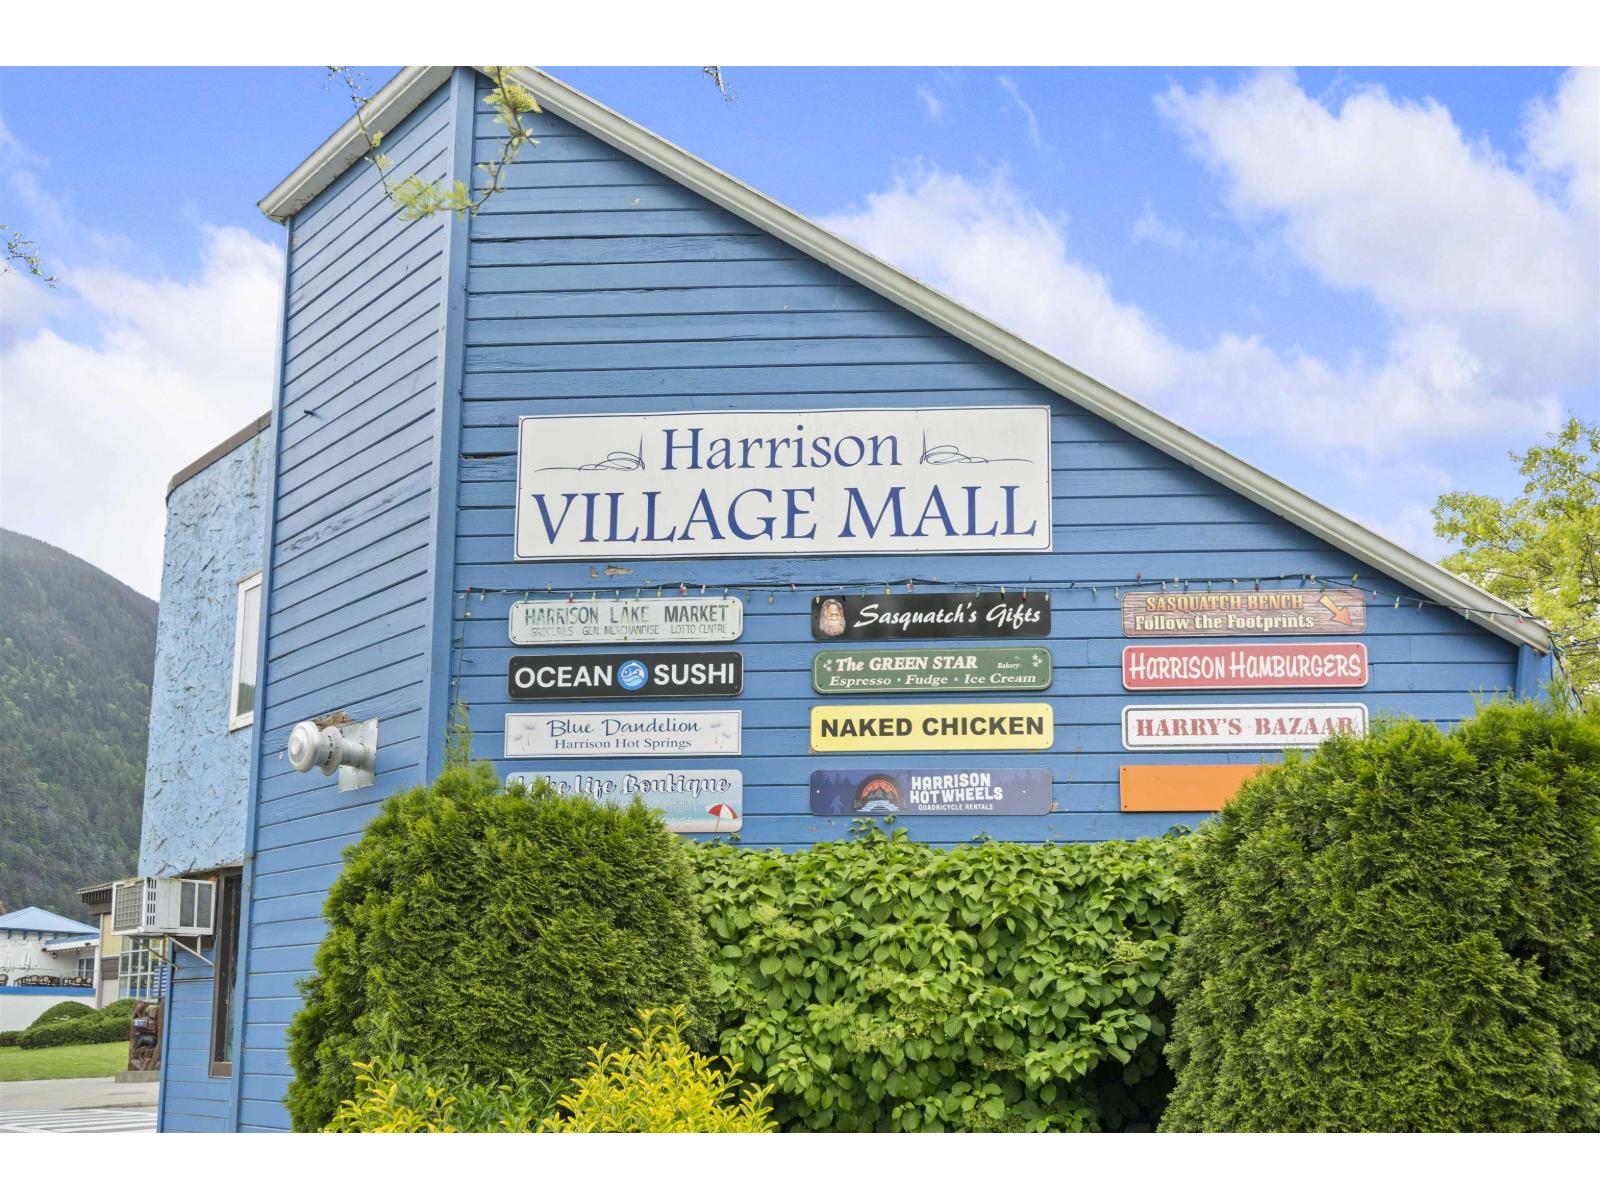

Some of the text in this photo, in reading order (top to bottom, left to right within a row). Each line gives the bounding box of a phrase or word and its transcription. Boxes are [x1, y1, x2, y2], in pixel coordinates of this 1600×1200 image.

[661, 424, 902, 471] Harrison
[531, 484, 1037, 544] VILLAGE MALL
[1146, 594, 1304, 613] SASQUATCH BENCH
[525, 604, 729, 625] HARRISON LAKE MARKET
[853, 602, 1041, 631] Sasquatch's Gifts
[1135, 614, 1314, 632] Follow the Footprints
[670, 624, 696, 635] LOTTO
[836, 655, 978, 672] The GREEN STAR
[514, 663, 734, 689] OCEAN SUSHI
[829, 673, 1036, 688] Espresso Fudge Ice Cream
[546, 718, 702, 737] Blue Dandelion
[821, 716, 1044, 738] NAKED CHICKEN
[1136, 717, 1356, 736] HARRY'S BAZAAR
[555, 738, 692, 750] Harrison Hot Springs
[622, 773, 731, 798] Boutique
[911, 772, 991, 790] HARRISON
[909, 786, 1003, 804] HOT WHEELS
[918, 803, 993, 811] QUADRICYCLE RENTALS
